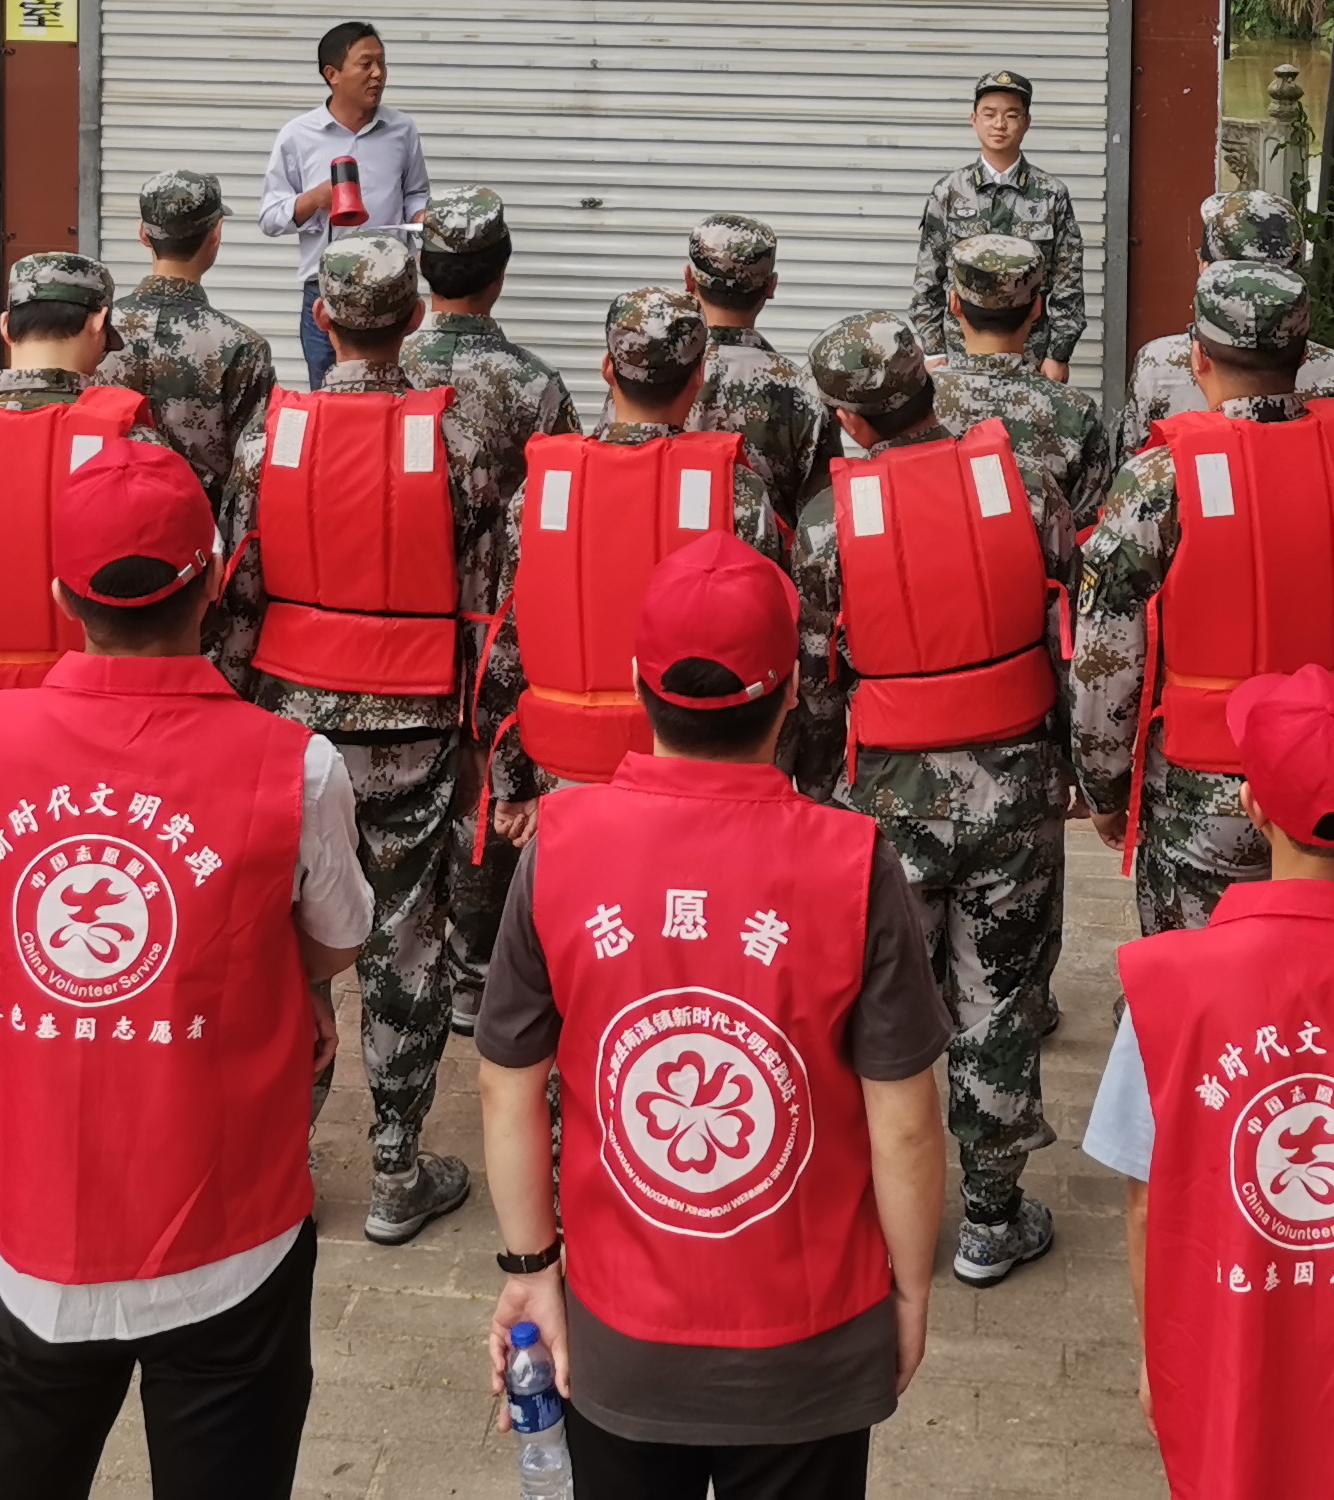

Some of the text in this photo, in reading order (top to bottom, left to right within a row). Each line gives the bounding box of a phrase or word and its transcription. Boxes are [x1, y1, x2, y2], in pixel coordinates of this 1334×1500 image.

[29, 844, 160, 900] 中国志愿服务
[584, 888, 791, 967] 志愿者
[21, 931, 163, 998] China Volunteer Service
[1241, 1181, 1271, 1226] China
